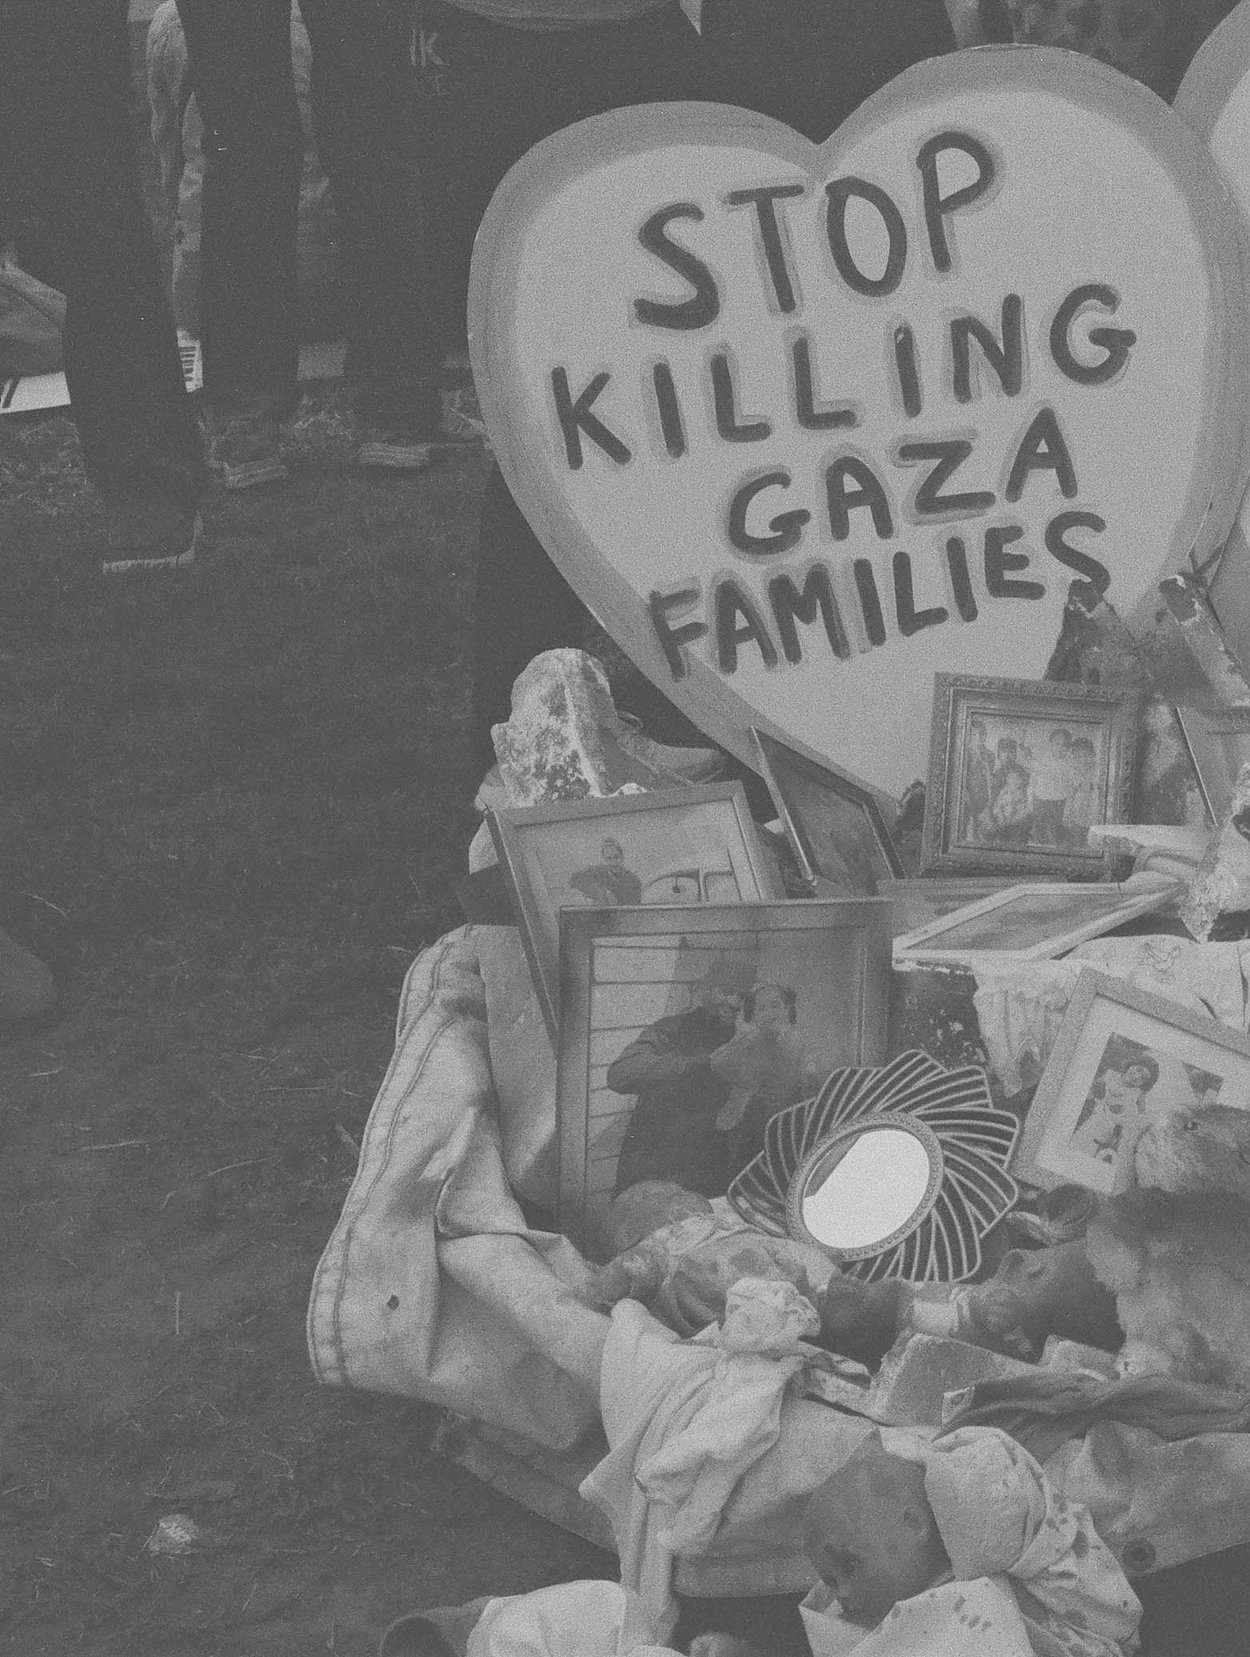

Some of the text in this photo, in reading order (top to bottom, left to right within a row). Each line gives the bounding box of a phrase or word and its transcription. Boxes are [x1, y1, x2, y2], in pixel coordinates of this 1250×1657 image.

[631, 130, 996, 331] STOP
[550, 283, 1138, 471] KILLING
[727, 406, 1079, 557] GAZA
[645, 510, 1111, 683] FAMILIES
